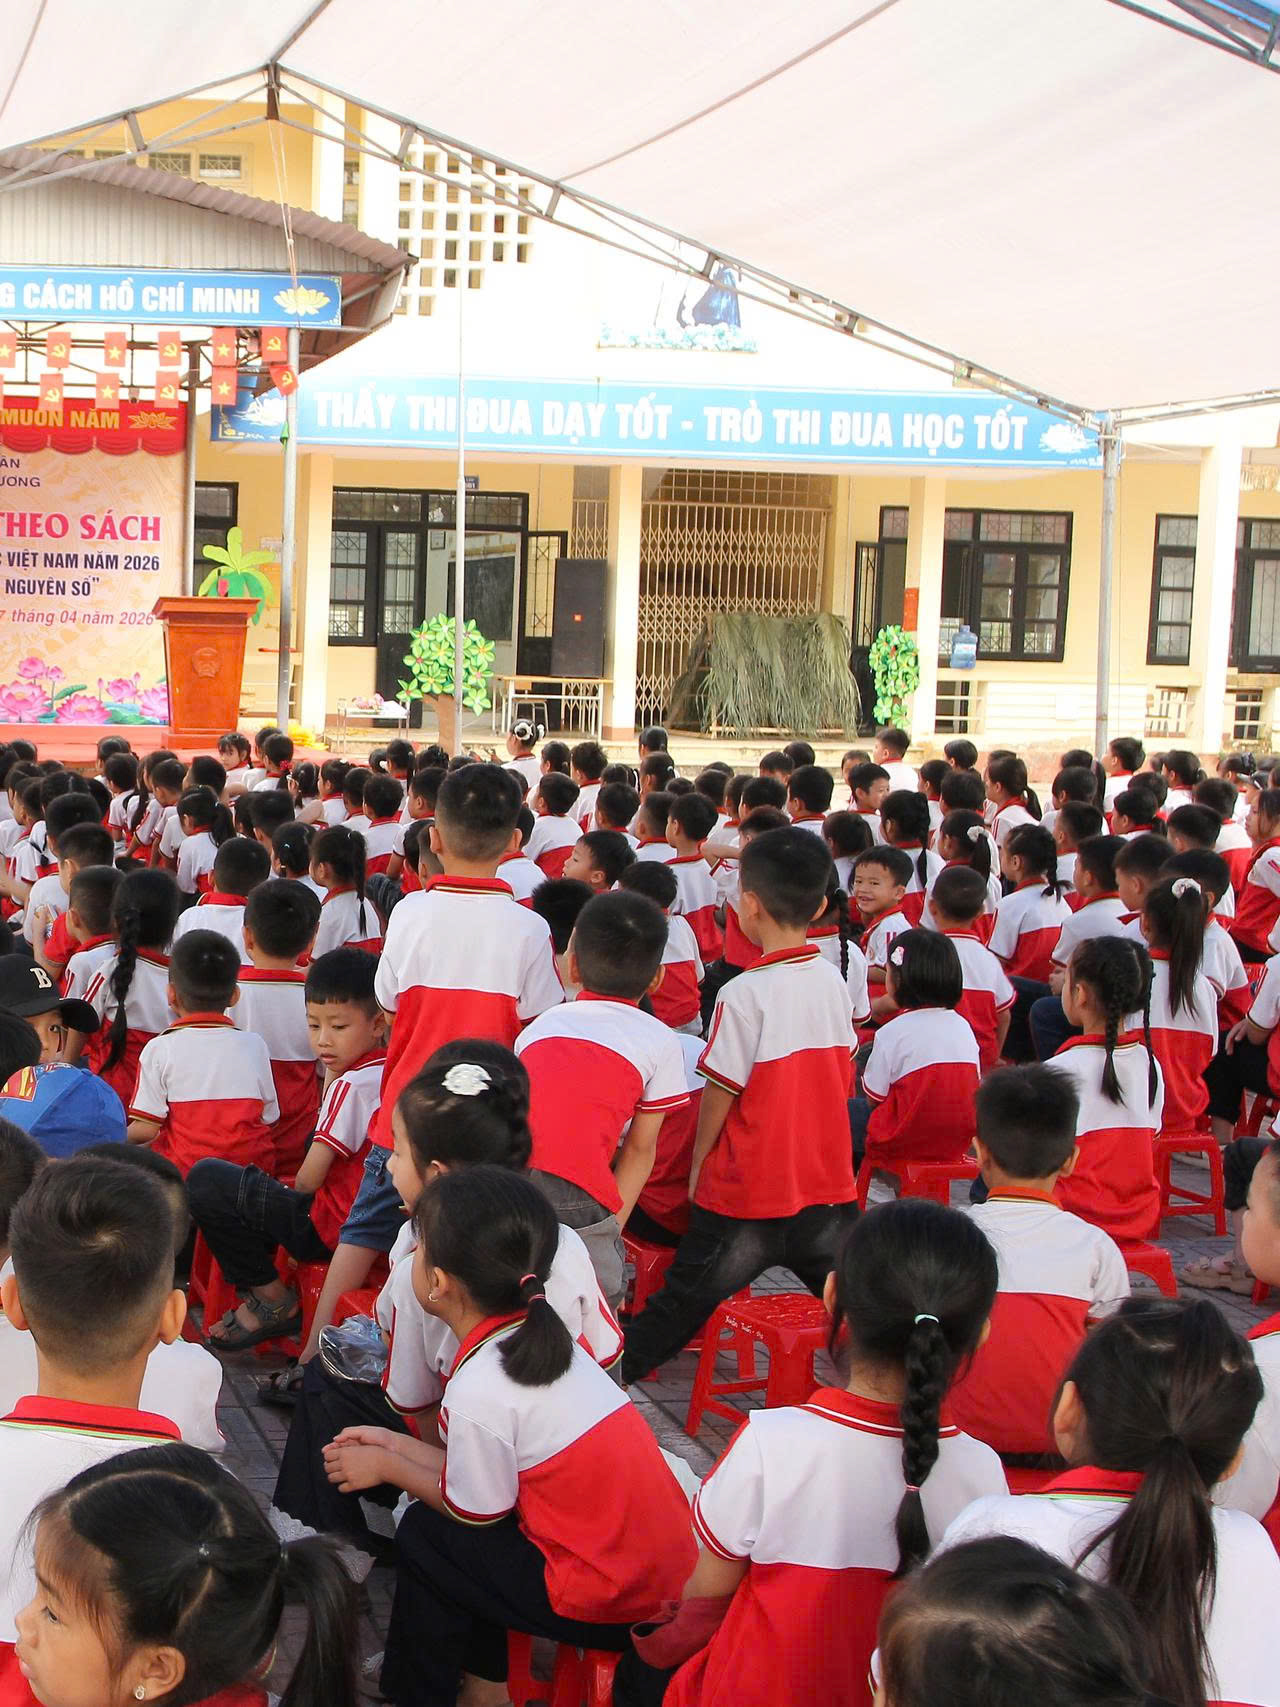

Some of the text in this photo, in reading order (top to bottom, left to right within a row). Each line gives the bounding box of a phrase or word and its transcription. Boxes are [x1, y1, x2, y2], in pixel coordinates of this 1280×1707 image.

[23, 277, 93, 310] CÁCH
[100, 277, 134, 311] HỒ
[142, 281, 185, 312] CHÍ
[192, 287, 260, 314] MINH
[70, 408, 119, 429] NĂM
[406, 395, 457, 432] THI
[466, 396, 532, 435] ĐUA
[542, 400, 605, 444] DẠY
[615, 392, 672, 440] TỐT
[703, 400, 763, 443] TRÒ
[772, 408, 821, 446] THI
[830, 410, 893, 448] ĐUA
[903, 413, 964, 456] HỌC
[973, 404, 1028, 450] TỐT
[80, 509, 161, 541] SÁCH
[7, 549, 38, 571] VIỆT
[43, 553, 78, 569] NAM
[84, 551, 119, 570] NĂM
[124, 556, 160, 571] 2026
[5, 576, 66, 596] NGUYÊN
[11, 608, 54, 626] tháng
[60, 611, 77, 624] 04
[83, 611, 113, 624] năm
[120, 612, 154, 625] 2026
[30, 968, 52, 988] B
